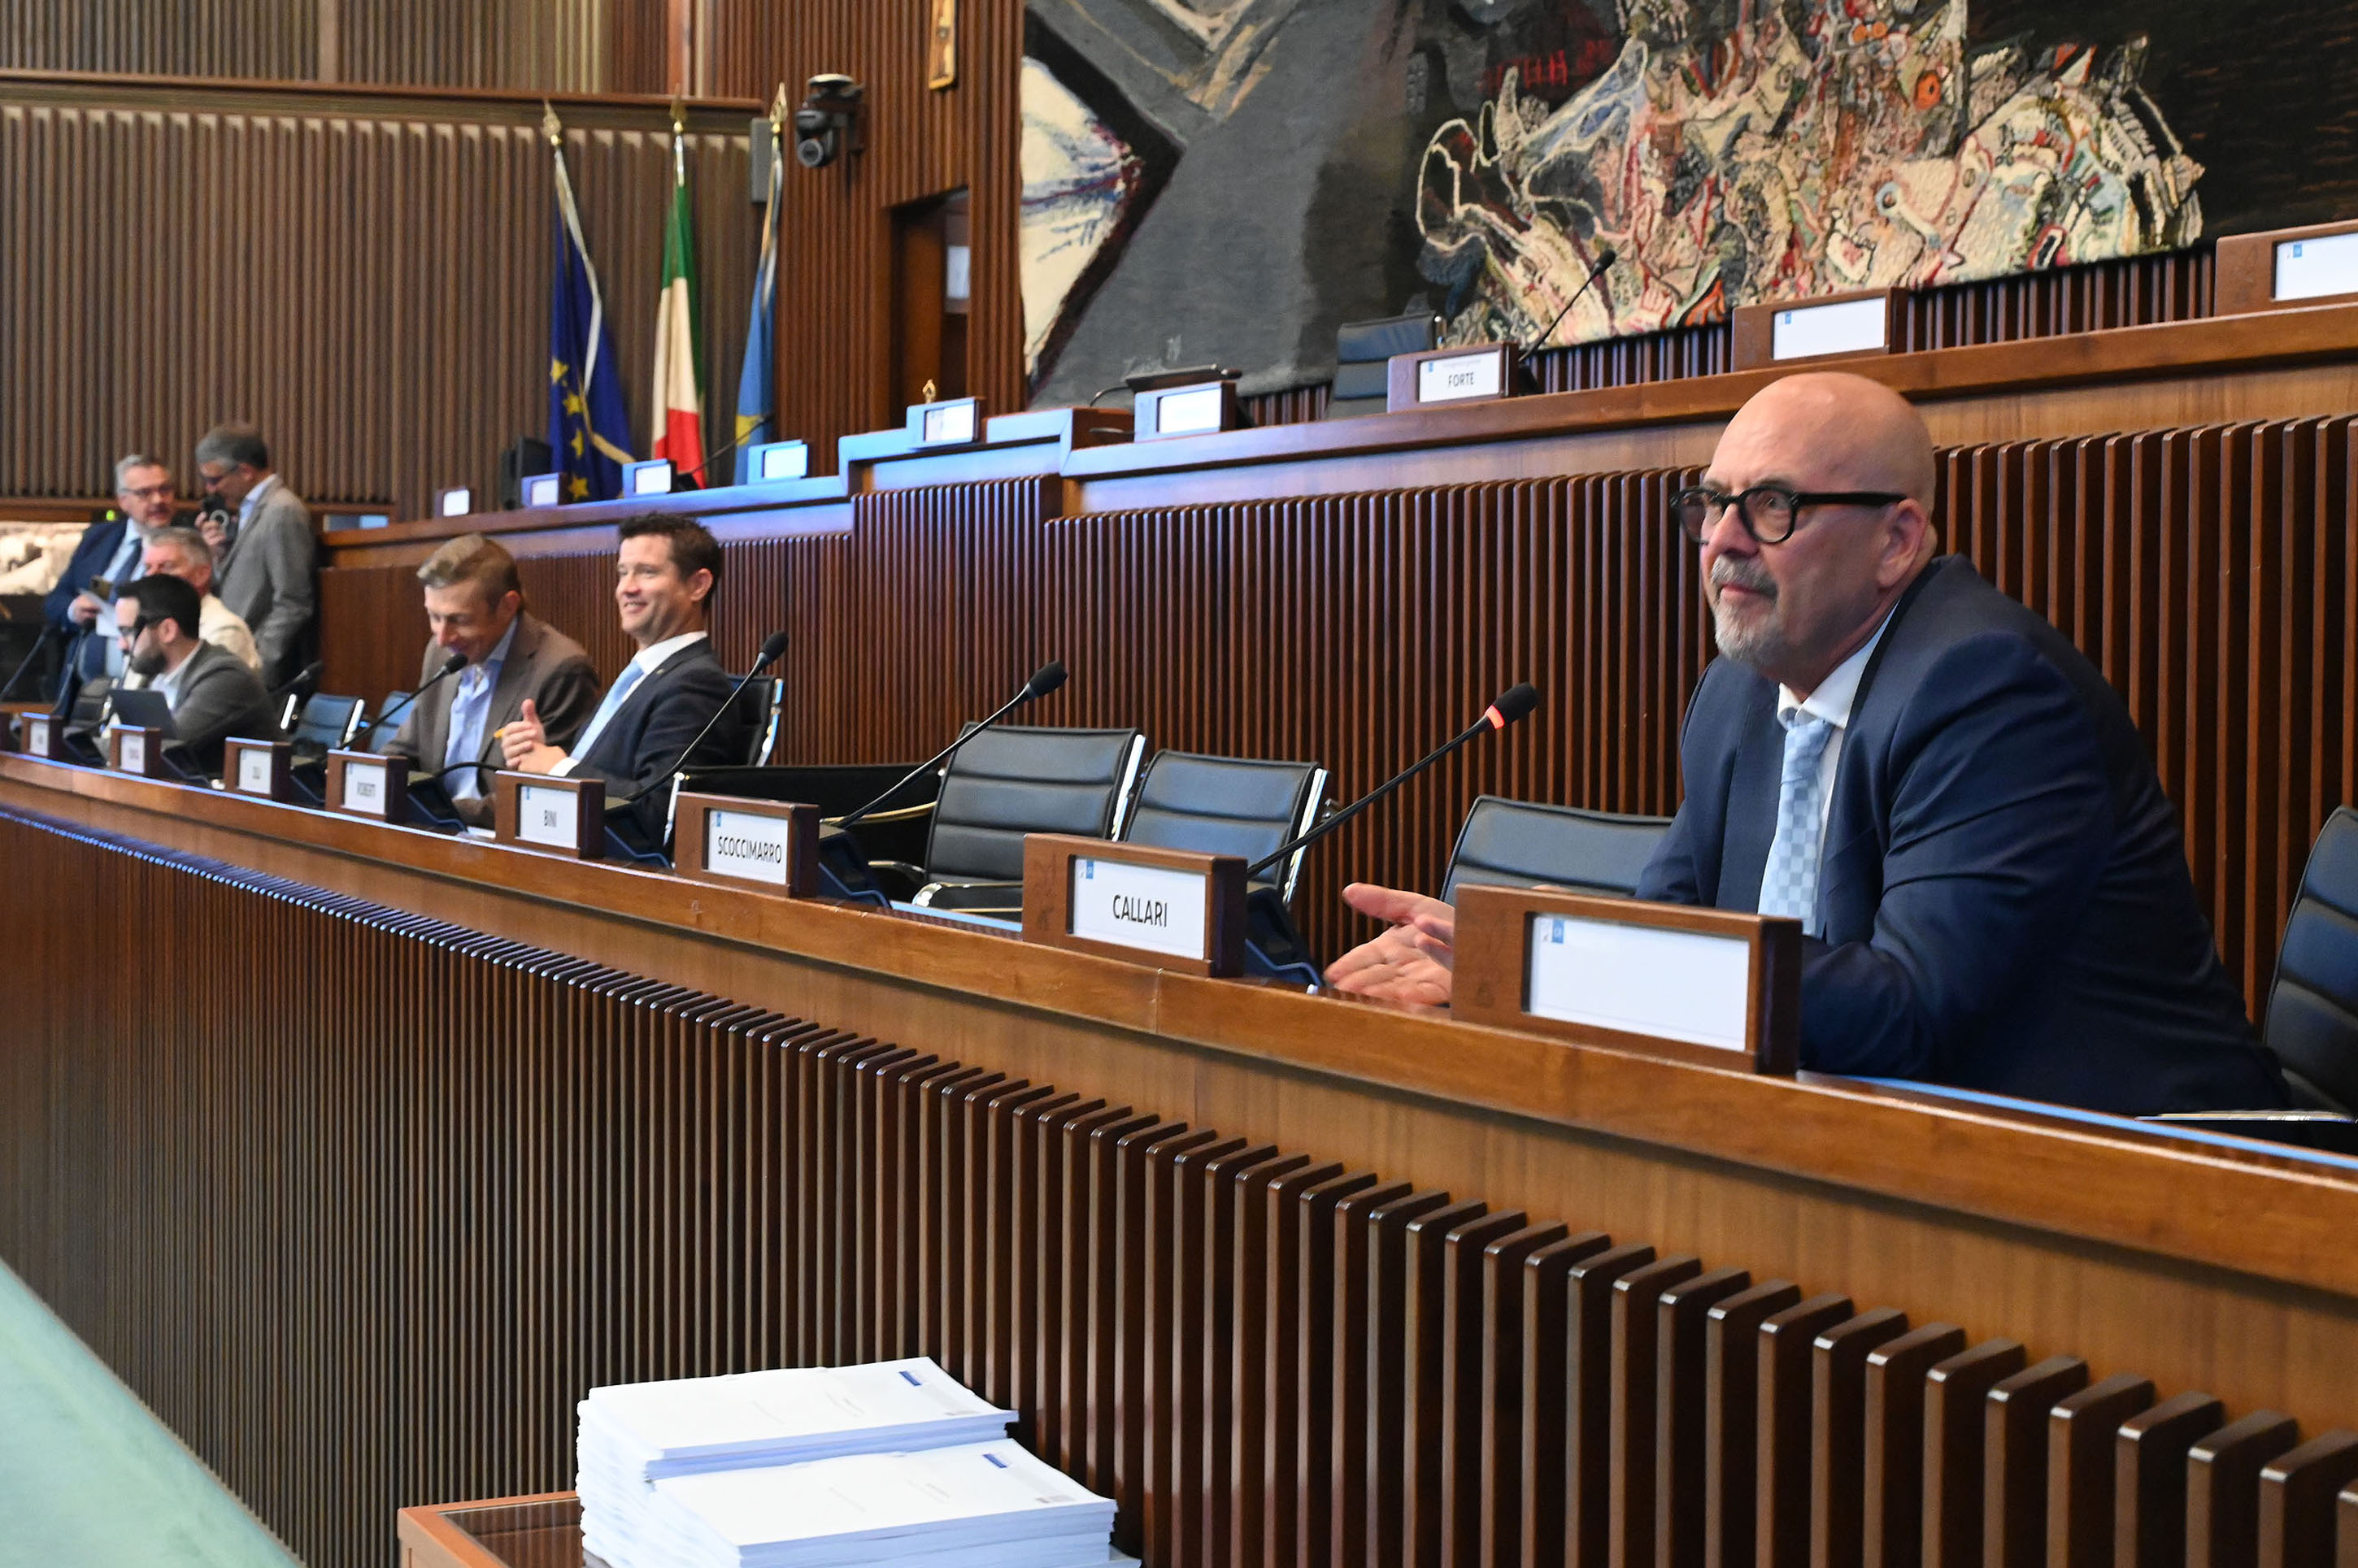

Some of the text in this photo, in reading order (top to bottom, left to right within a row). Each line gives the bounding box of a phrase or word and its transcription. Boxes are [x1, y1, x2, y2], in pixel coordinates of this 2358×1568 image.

[1447, 371, 1475, 387] FORTE
[718, 836, 782, 864] SCOCCIMARRO
[1112, 894, 1168, 928] CALLARI
